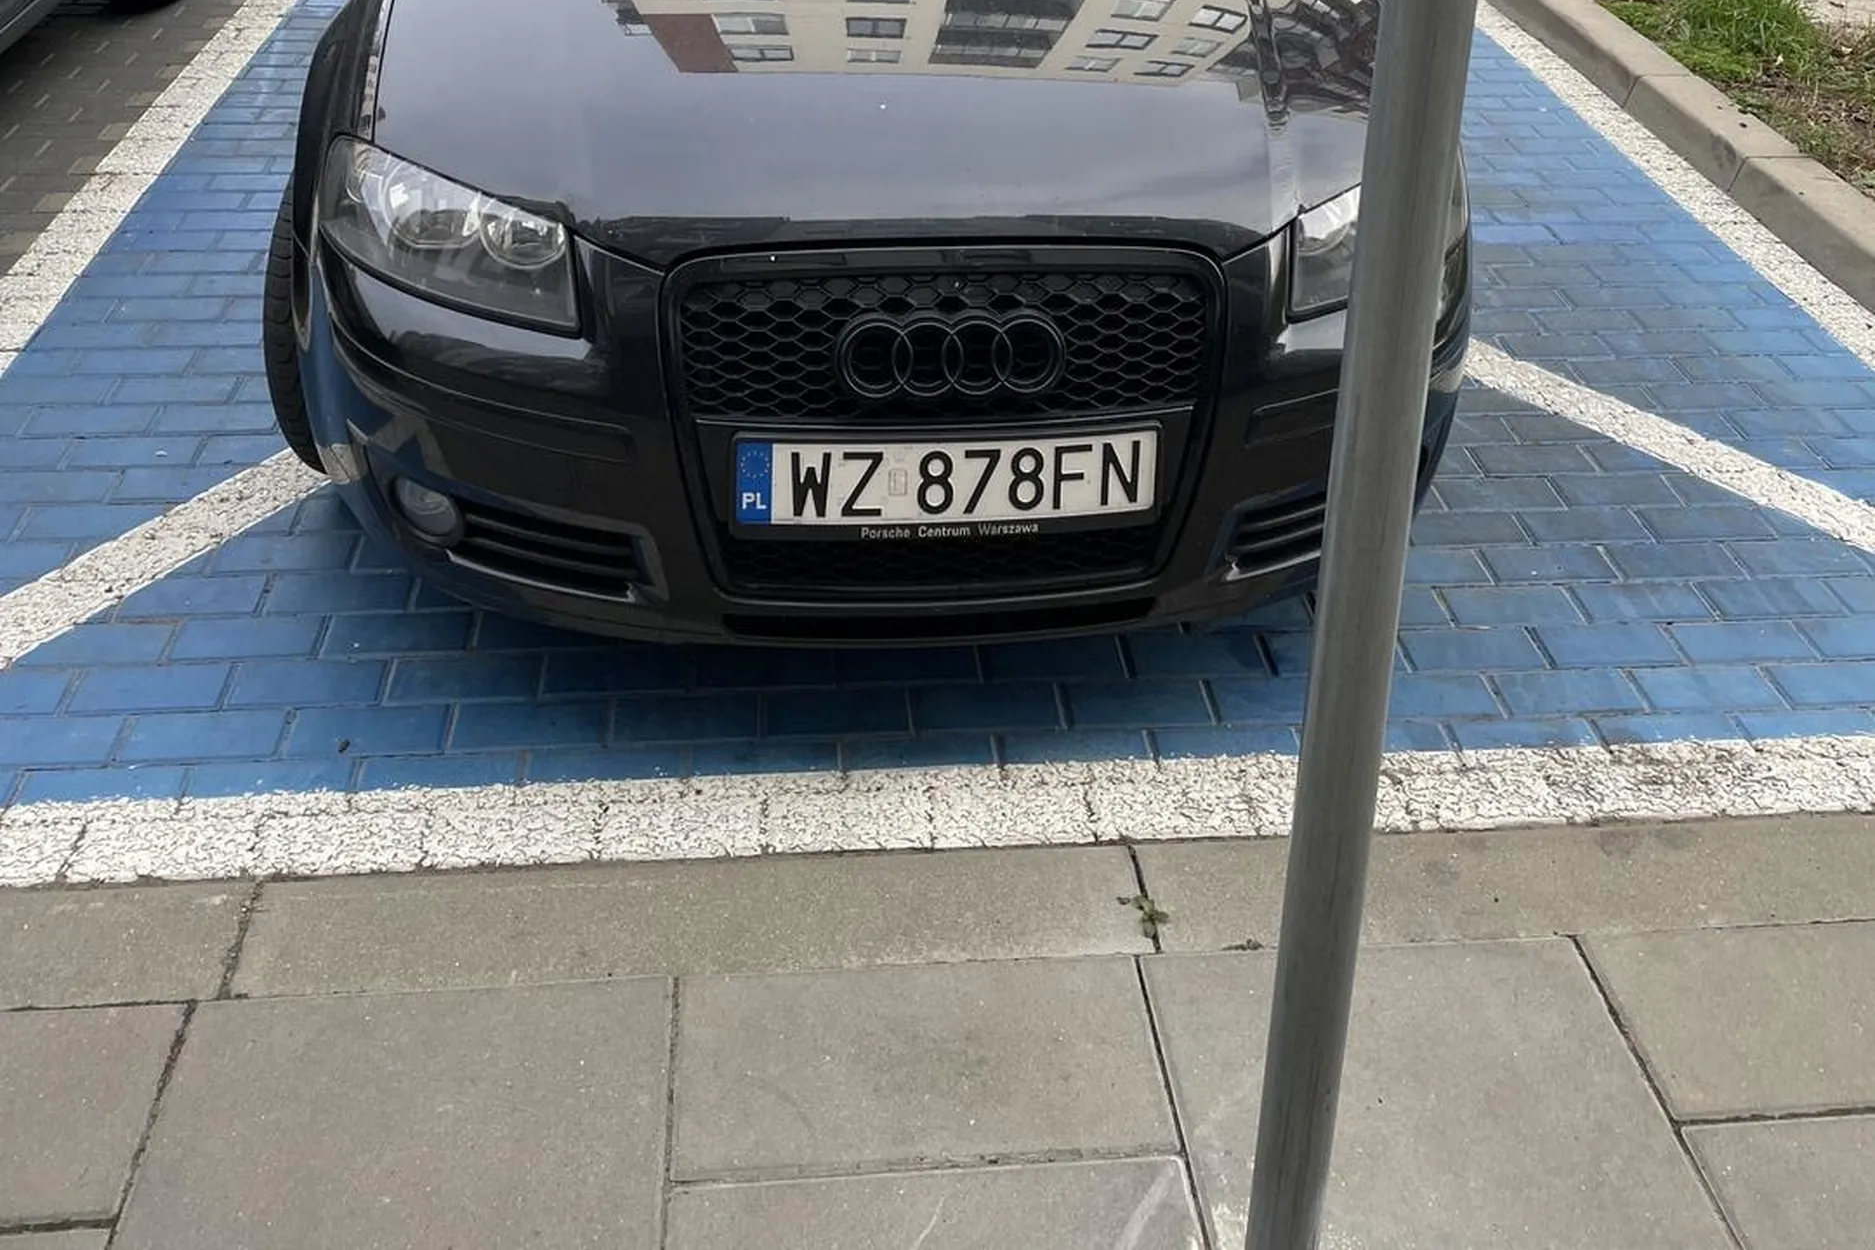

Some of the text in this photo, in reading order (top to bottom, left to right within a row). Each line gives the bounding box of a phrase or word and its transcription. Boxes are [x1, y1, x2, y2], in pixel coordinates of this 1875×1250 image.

[791, 440, 1140, 518] WZ 878FN
[742, 492, 767, 510] PL
[860, 523, 1039, 539] Porsche Centrum Warszawa
